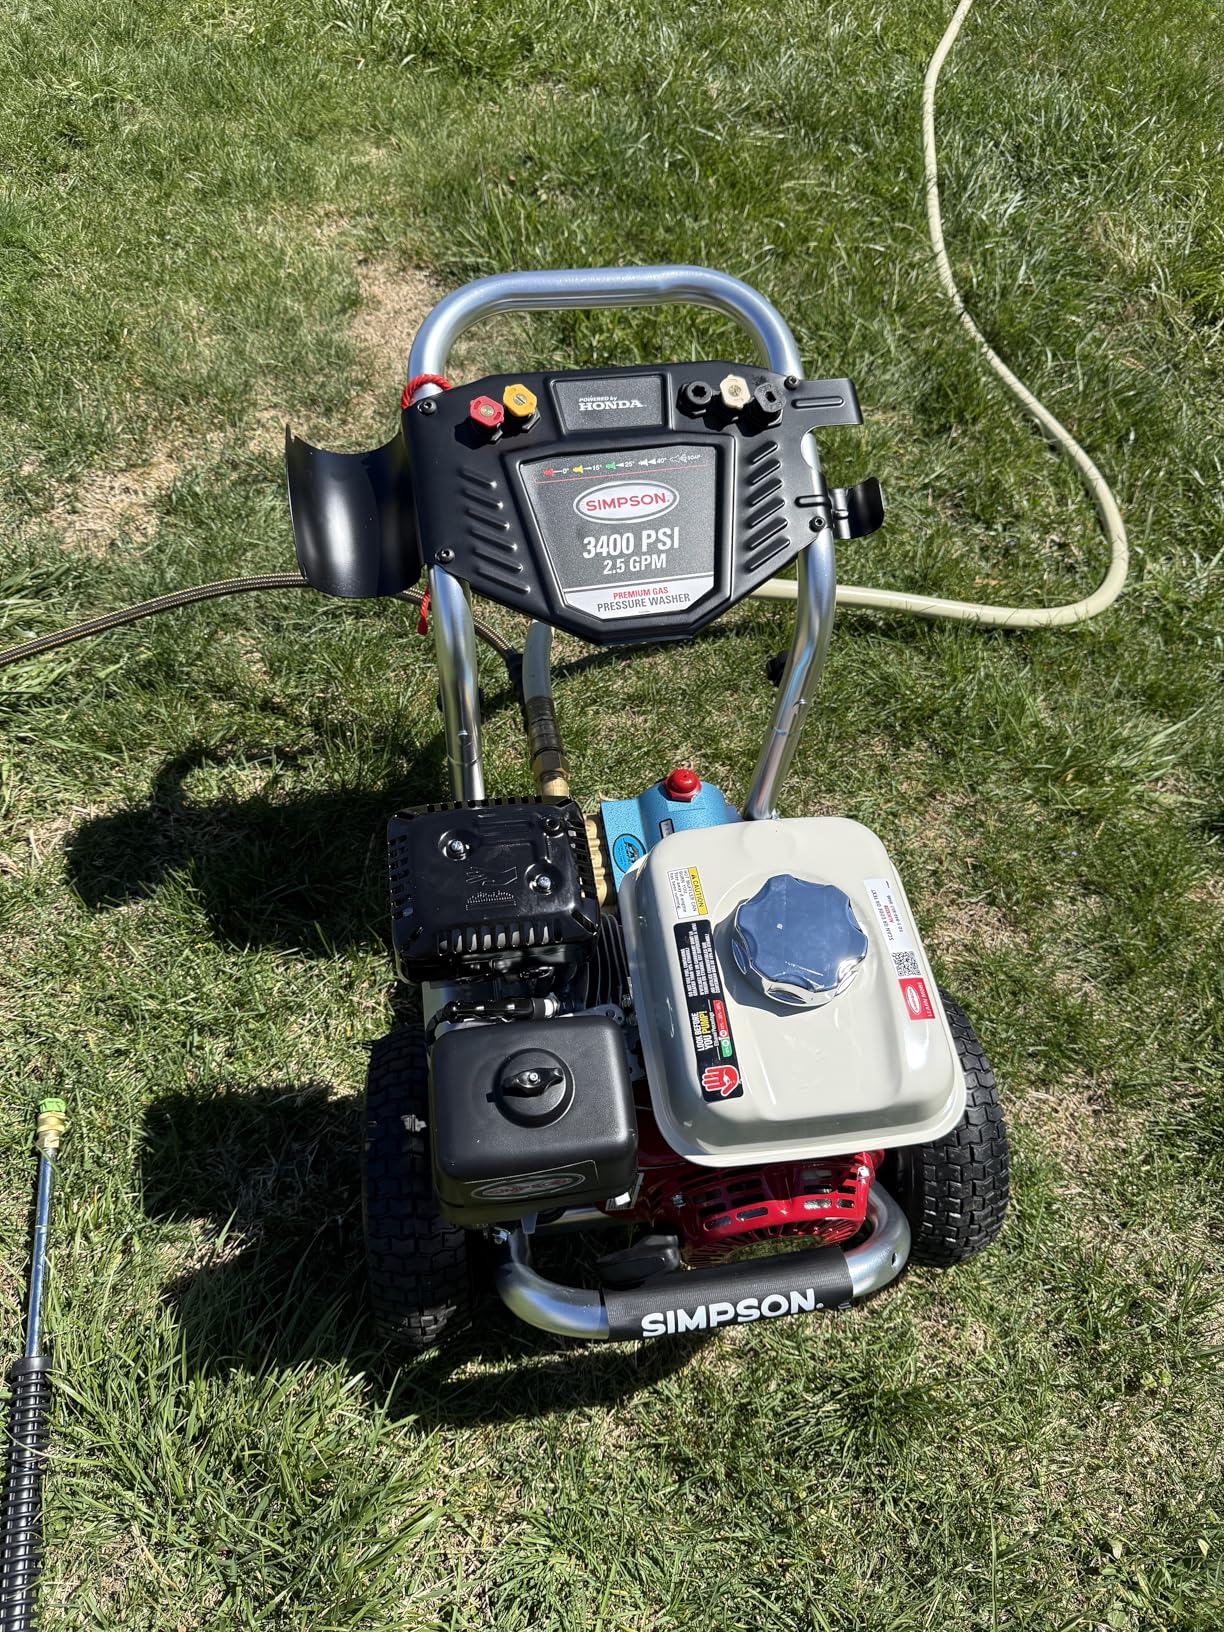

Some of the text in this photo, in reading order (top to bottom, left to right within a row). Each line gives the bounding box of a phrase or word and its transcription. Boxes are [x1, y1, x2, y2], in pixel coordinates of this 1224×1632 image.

[579, 400, 645, 411] HONDA
[582, 527, 680, 559] 3400 PSI
[603, 553, 667, 575] 2.5 GPM
[597, 593, 691, 612] PRESSURE WASHER
[613, 586, 669, 600] PREMIUM GAS
[693, 880, 704, 907] CAUTION
[886, 928, 894, 940] SCAN
[691, 1012, 705, 1051] LOOK BEFORE
[698, 1010, 713, 1050] YOU PUMP!
